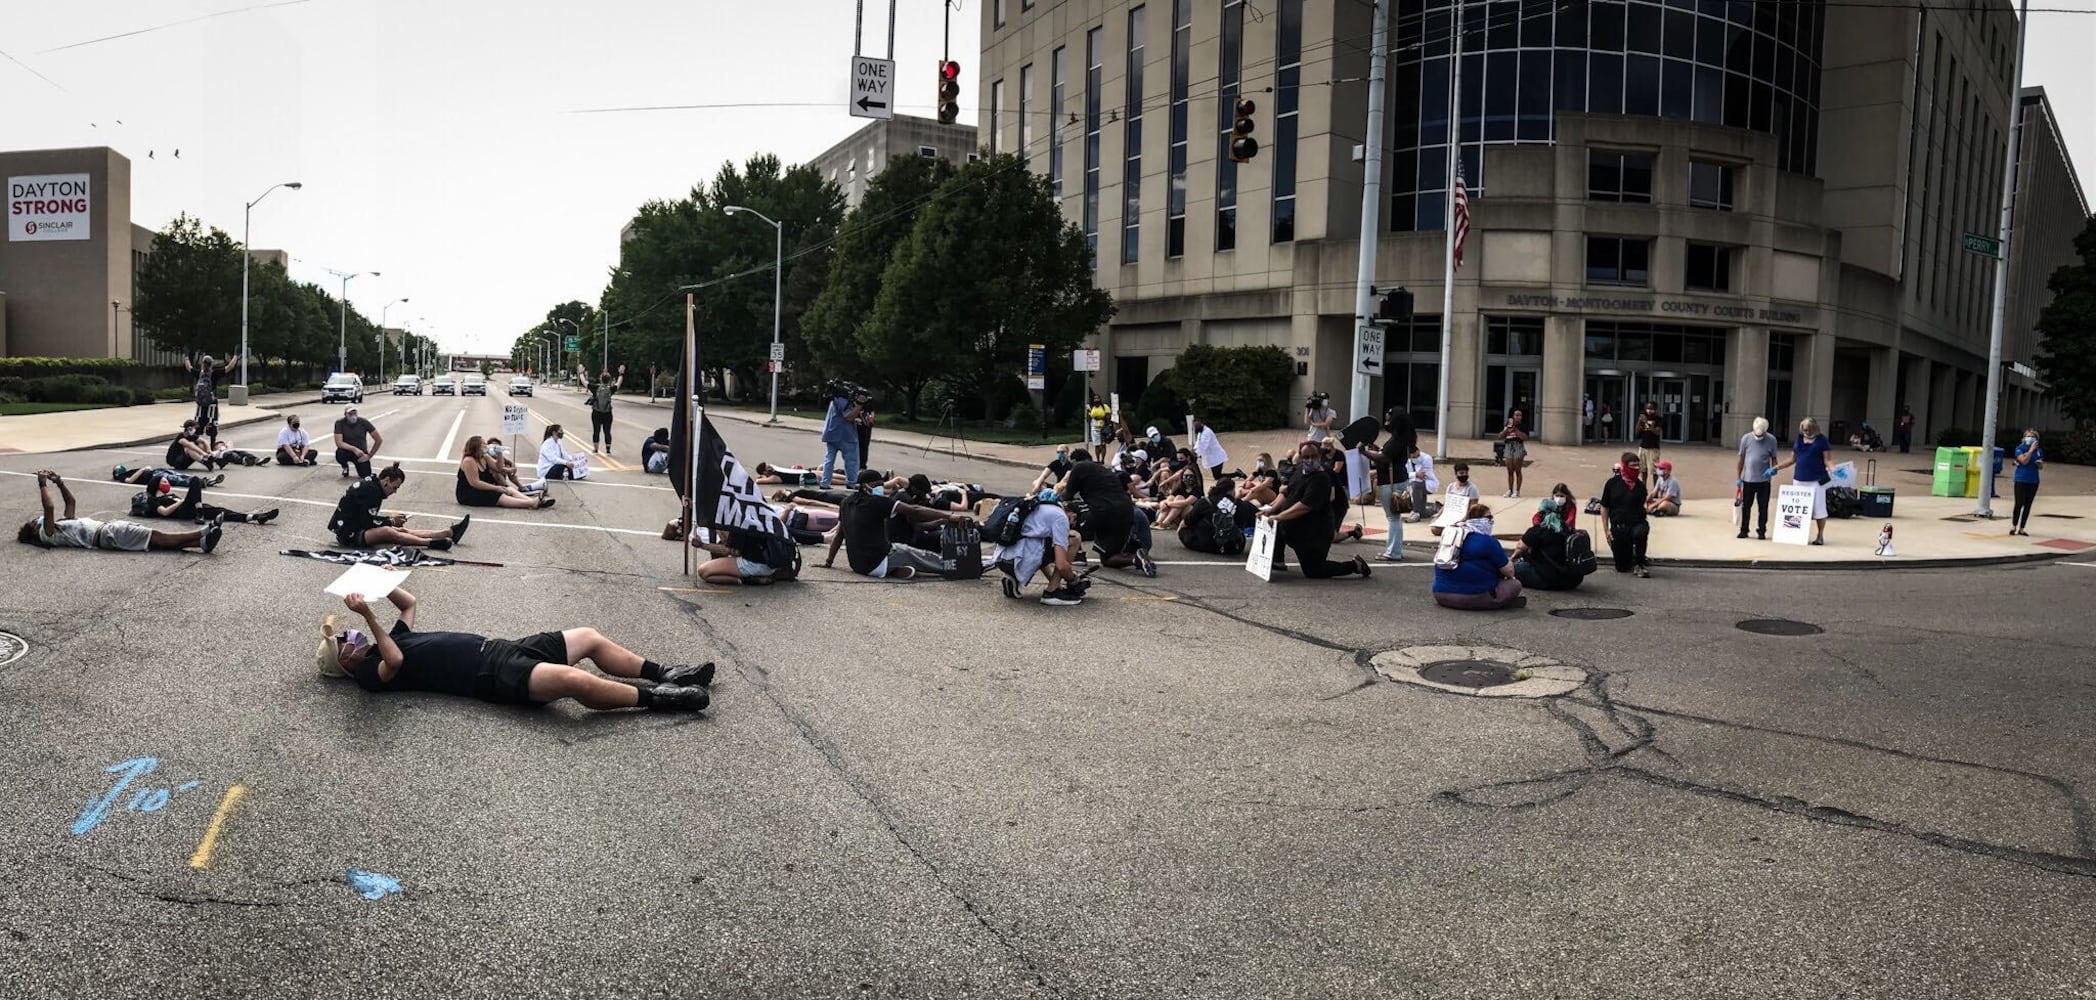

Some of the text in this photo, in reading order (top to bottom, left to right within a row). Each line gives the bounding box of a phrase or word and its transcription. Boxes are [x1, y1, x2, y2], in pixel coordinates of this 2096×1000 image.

[859, 62, 887, 78] ONE
[857, 78, 887, 94] WAY
[13, 181, 86, 197] DAYTON
[12, 199, 87, 215] STRONG
[38, 221, 73, 229] SINCLAIR
[1968, 237, 1990, 252] PERRY
[1507, 294, 1558, 307] DAYTON
[1661, 300, 1709, 315] COUNTY
[1363, 330, 1381, 343] ONE
[1362, 342, 1381, 355] WAY
[1781, 490, 1812, 498] REGISTER
[715, 494, 790, 539] MAT
[1781, 504, 1809, 515] VOTE
[956, 545, 968, 557] BY
[943, 559, 957, 571] THE
